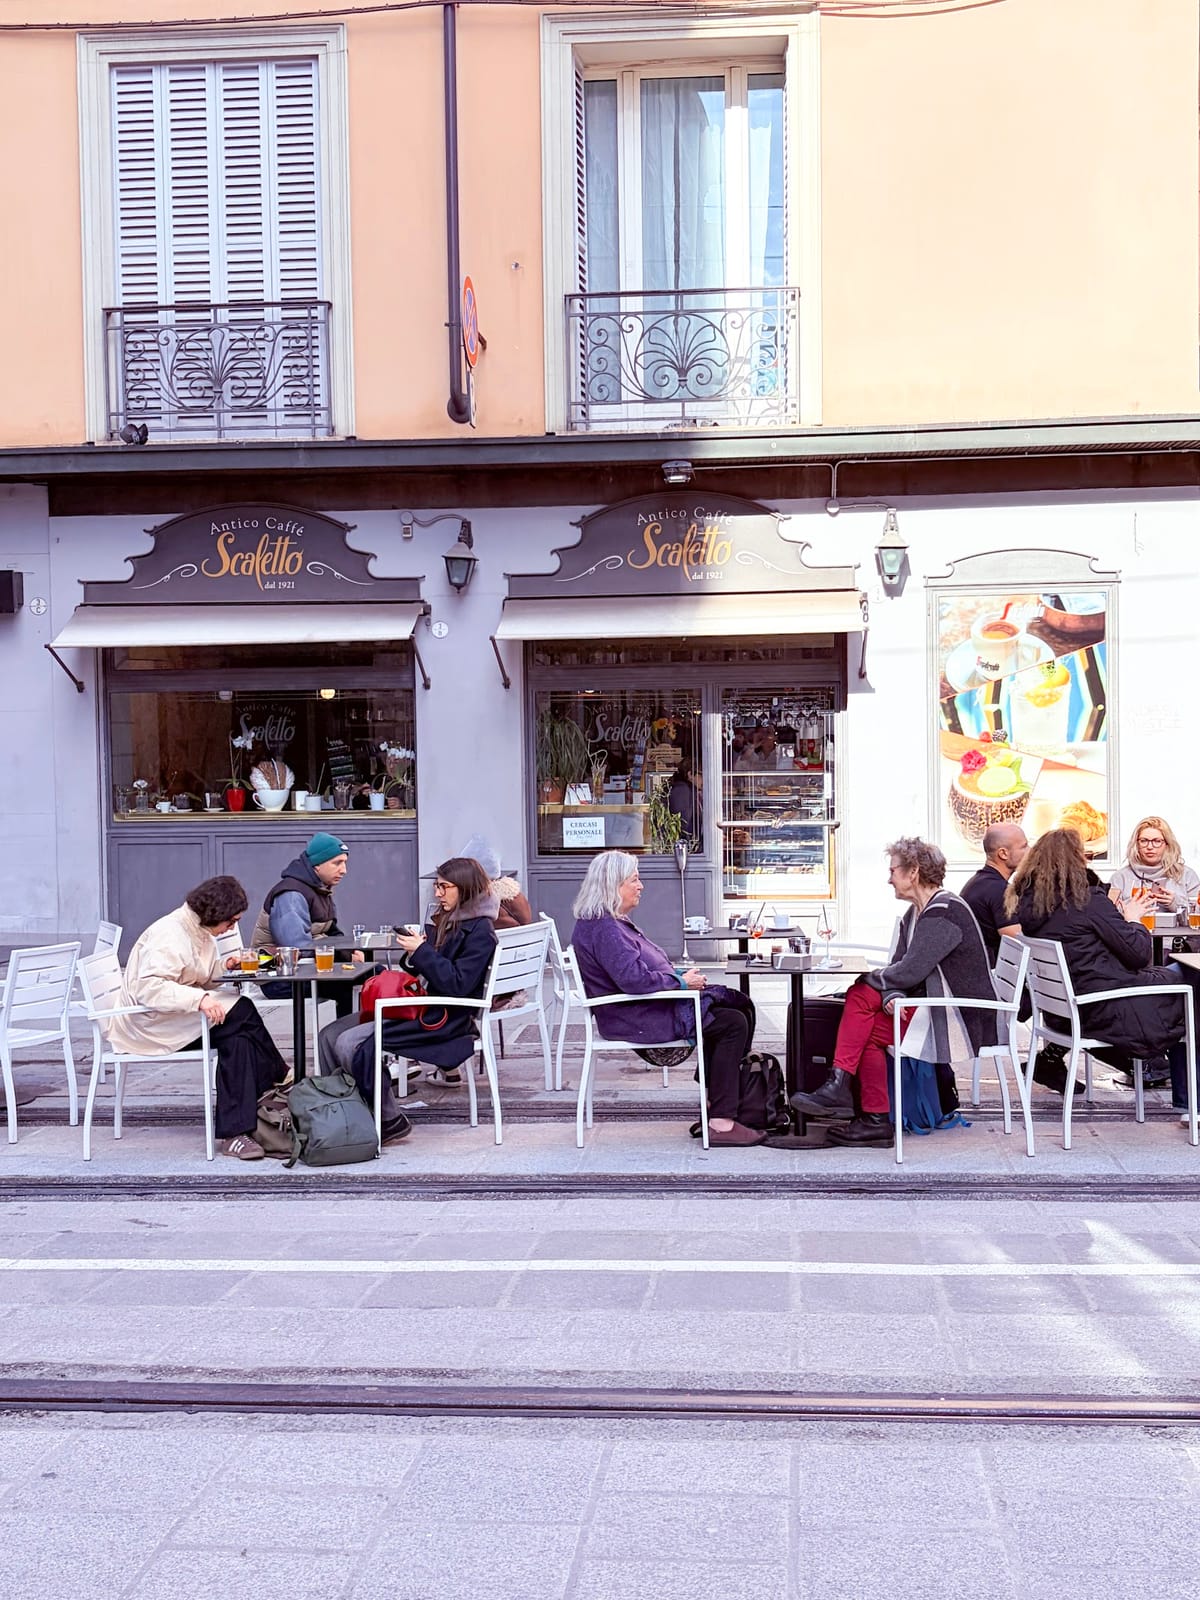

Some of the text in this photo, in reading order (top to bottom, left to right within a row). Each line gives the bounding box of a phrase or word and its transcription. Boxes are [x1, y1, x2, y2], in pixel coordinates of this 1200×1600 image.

[637, 508, 687, 526] Antico
[210, 518, 259, 535] Antico
[627, 522, 733, 582] Scaletto
[201, 531, 304, 592] Scaletto
[692, 571, 723, 580] dal 1921
[264, 581, 295, 589] dal 1921
[585, 713, 653, 752] Scaletto
[570, 821, 598, 829] CERCASI
